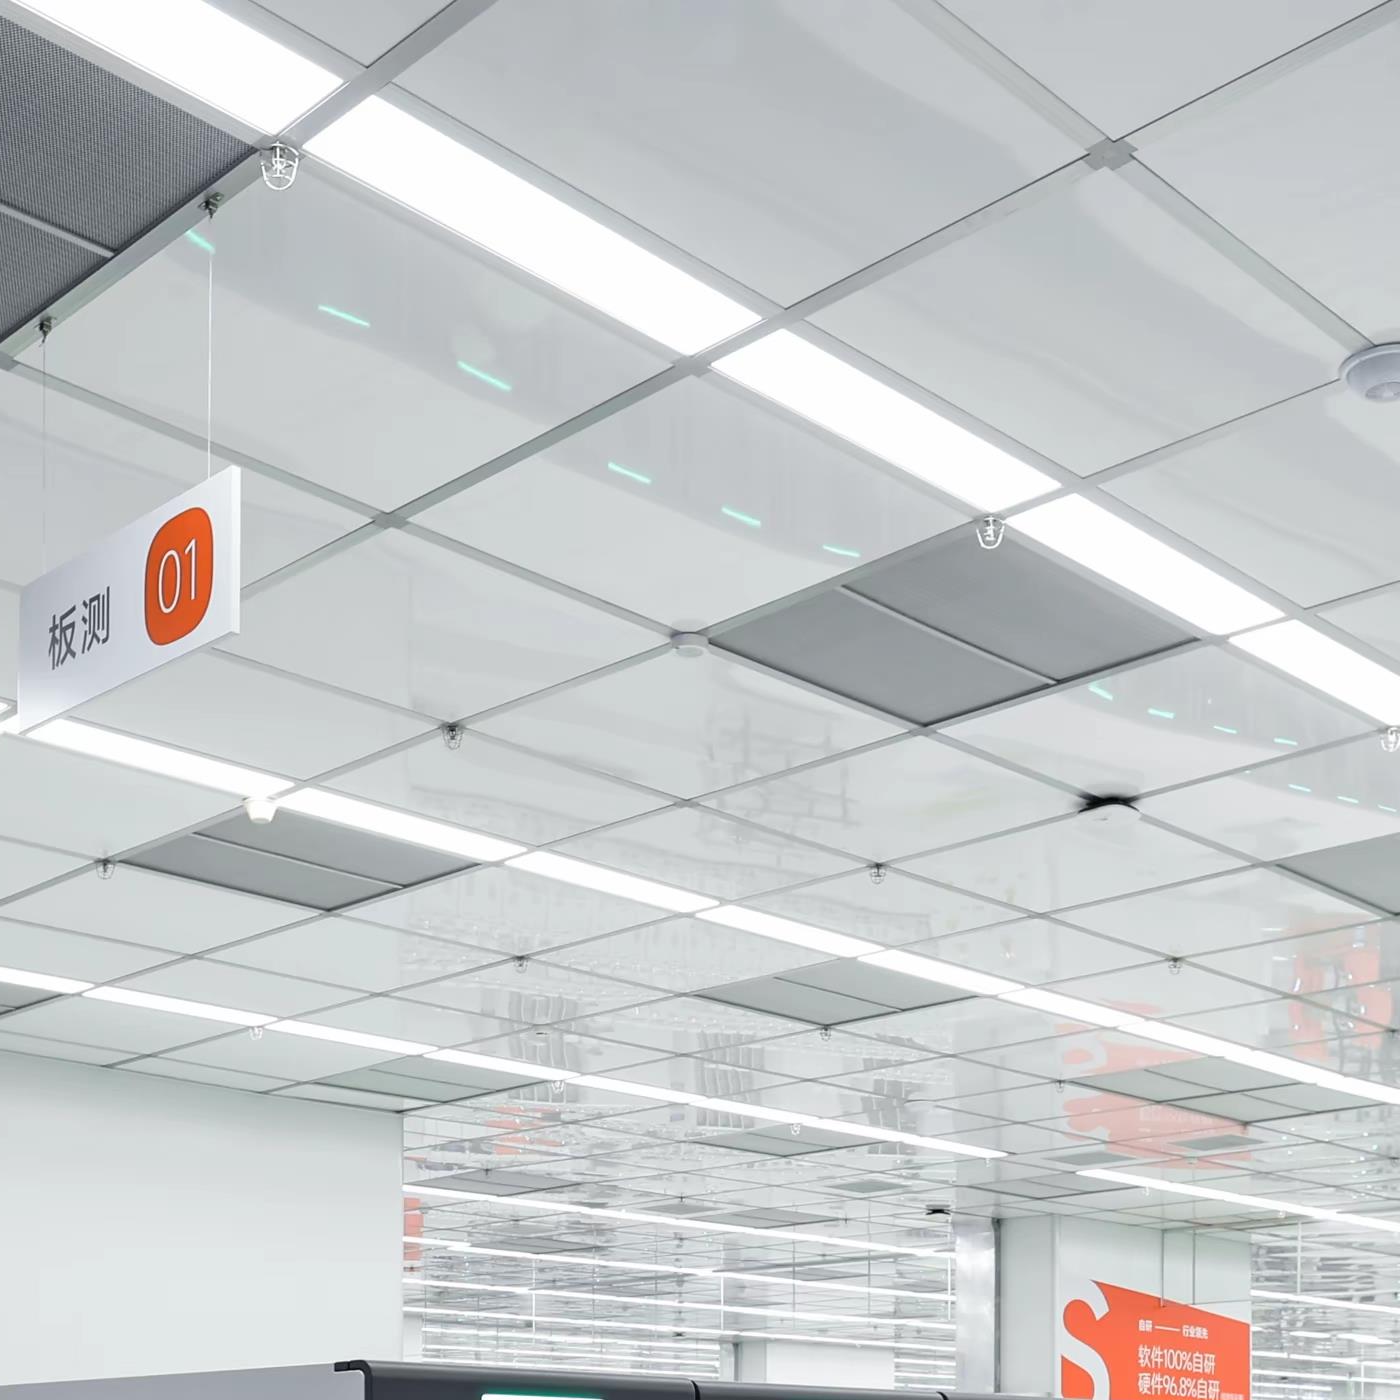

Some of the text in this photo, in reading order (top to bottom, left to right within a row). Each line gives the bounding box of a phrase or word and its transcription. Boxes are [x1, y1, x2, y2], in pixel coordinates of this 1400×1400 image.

[48, 537, 197, 671] 板测 01
[1138, 1344, 1216, 1375] 软件100%自研
[1138, 1372, 1220, 1400] 硬件96.8%自研
